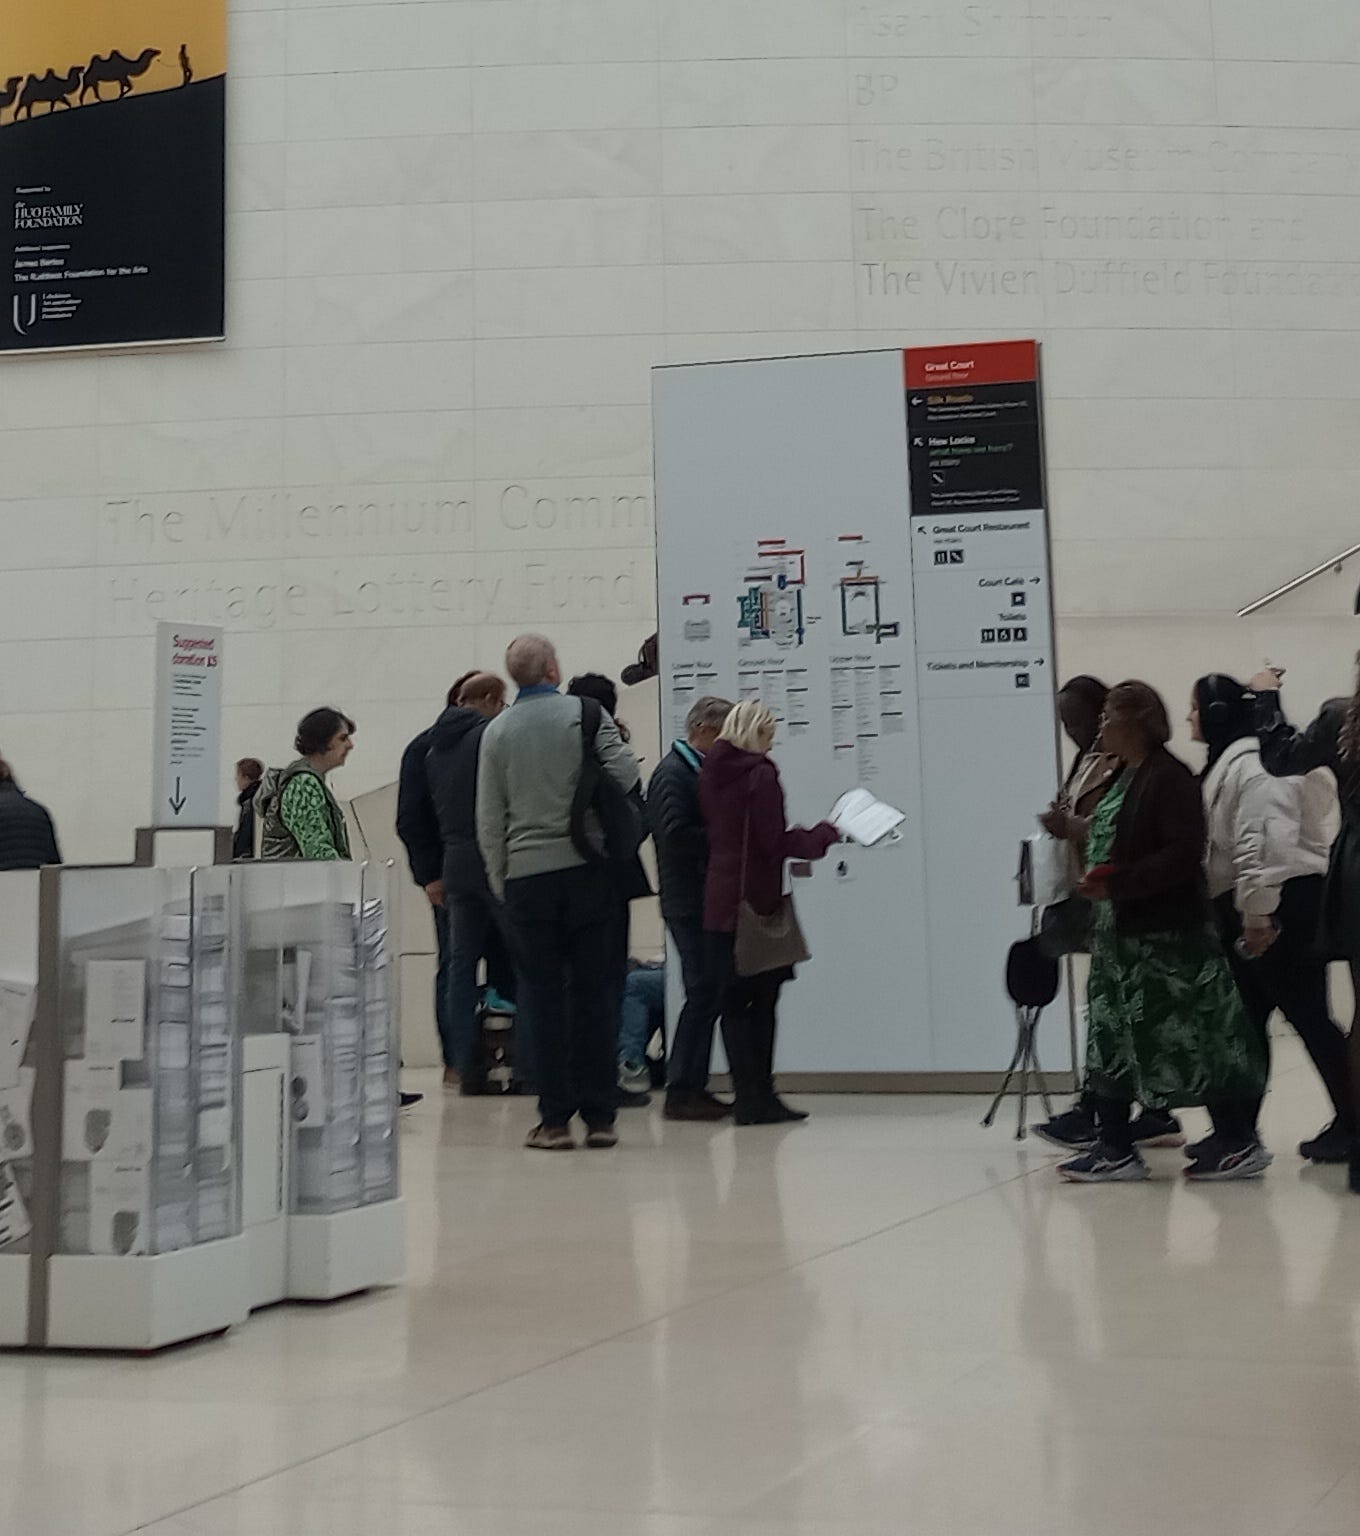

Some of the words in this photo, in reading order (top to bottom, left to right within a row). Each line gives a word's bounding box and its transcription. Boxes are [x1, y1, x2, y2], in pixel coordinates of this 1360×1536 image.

[855, 72, 898, 106] BP
[852, 138, 912, 172] The
[924, 137, 1037, 173] British
[42, 203, 83, 216] FAMILY
[15, 215, 83, 229] FOUNDATION
[856, 206, 918, 242] The
[939, 205, 1027, 243] Clore
[1041, 205, 1232, 243] Foundation
[860, 261, 922, 297] The
[934, 260, 1039, 297] Vivien
[1054, 260, 1193, 297] Duffield
[924, 362, 949, 371] Great
[950, 360, 975, 370] Court
[105, 497, 184, 545] The
[204, 493, 473, 543] Millennium
[932, 526, 956, 534] Great
[958, 524, 982, 533] Court
[978, 578, 1003, 587] Court
[109, 576, 308, 629] Heritage
[332, 569, 503, 621] Lottery
[525, 562, 637, 610] Fund
[958, 661, 975, 670] and
